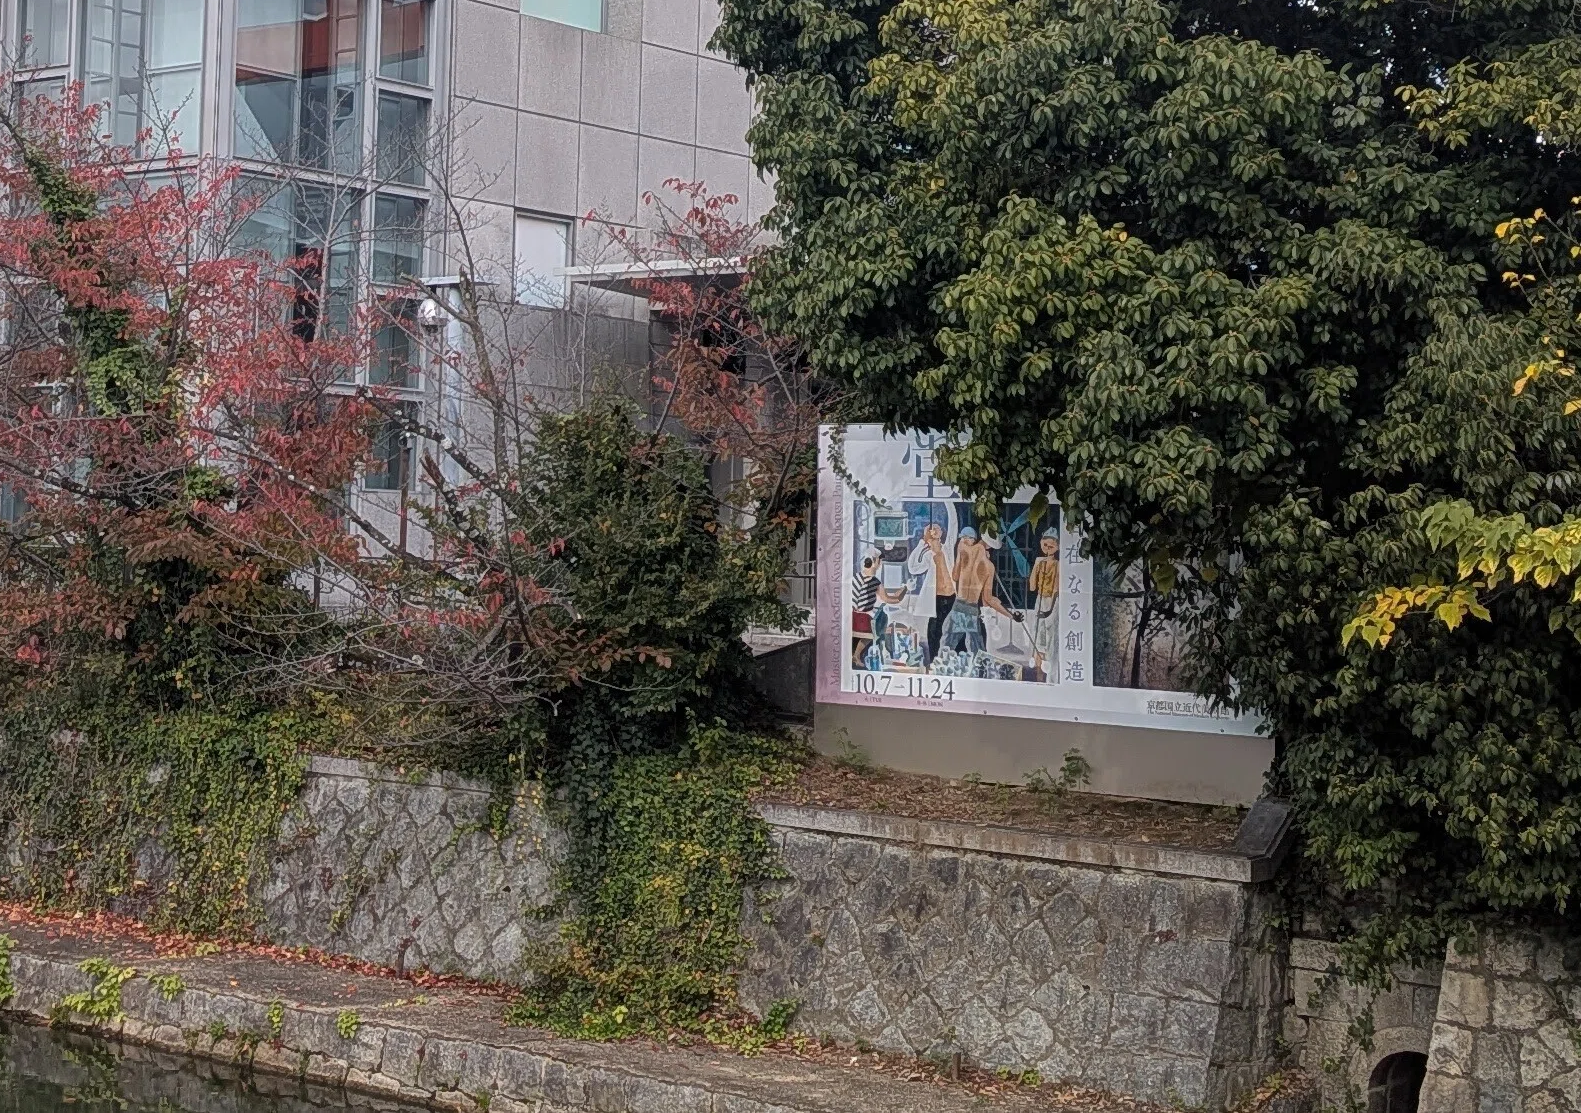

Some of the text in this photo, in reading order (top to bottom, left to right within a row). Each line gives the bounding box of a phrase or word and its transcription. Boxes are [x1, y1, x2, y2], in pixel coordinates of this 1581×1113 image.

[831, 501, 844, 549] Nihonga
[831, 552, 843, 582] Kyoto
[830, 586, 840, 631] Modern
[830, 632, 840, 645] of
[829, 649, 840, 686] Master
[855, 673, 892, 695] 10.7
[907, 676, 956, 701] 11.24
